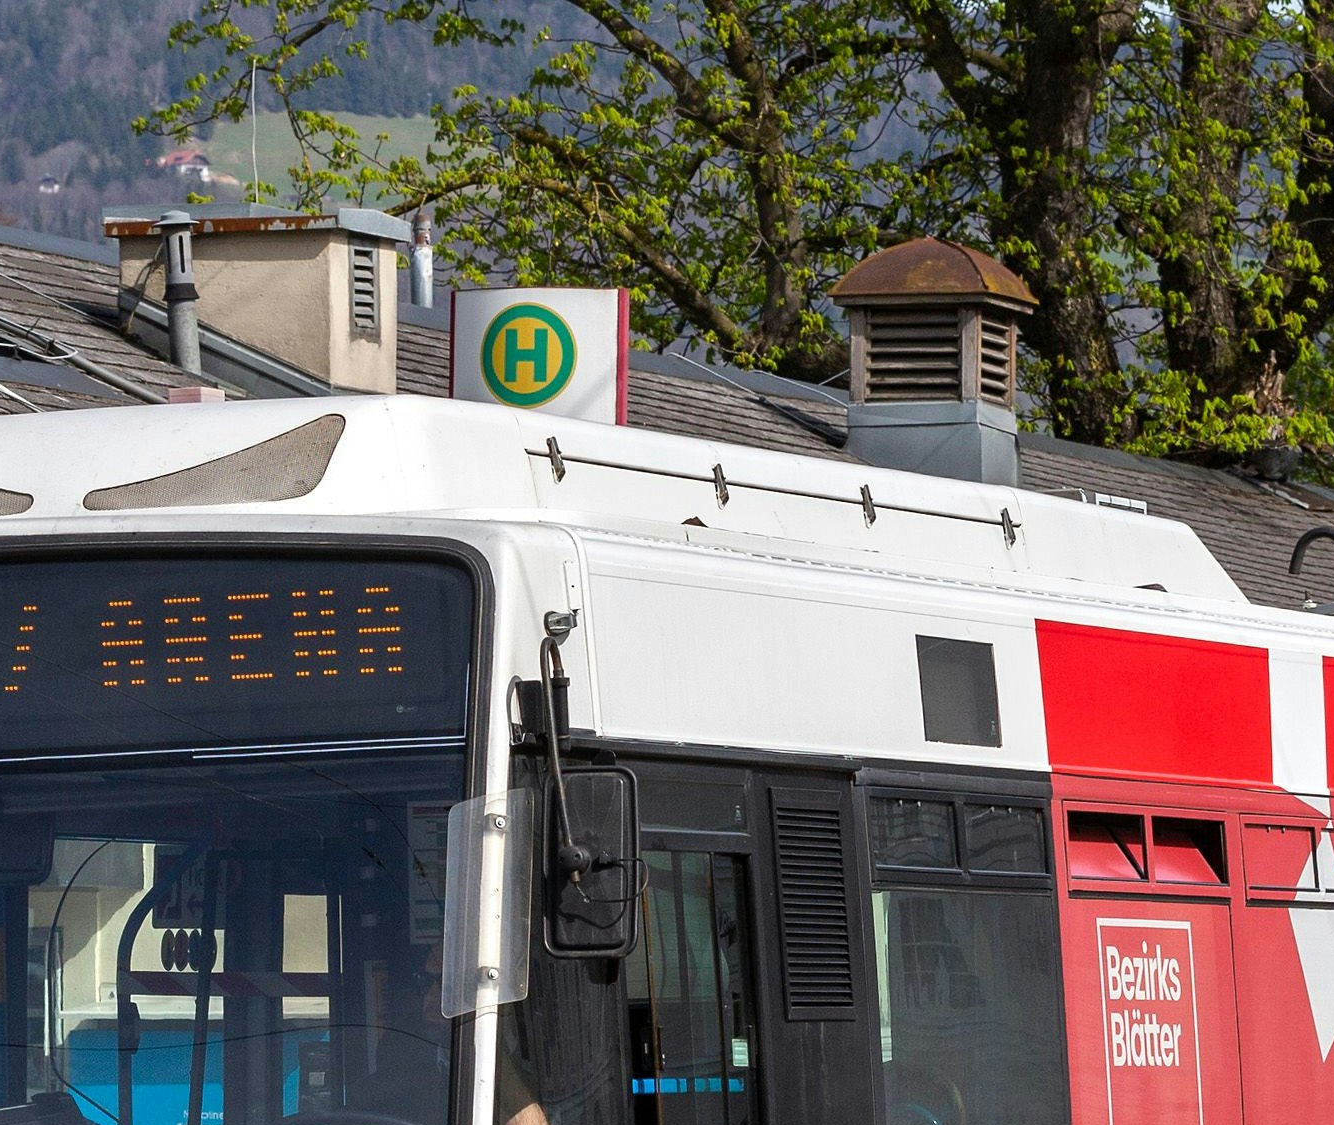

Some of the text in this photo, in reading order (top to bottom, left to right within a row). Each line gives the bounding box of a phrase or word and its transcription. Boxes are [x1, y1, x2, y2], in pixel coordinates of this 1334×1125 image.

[503, 328, 549, 383] H
[100, 586, 404, 687] ARENA
[1106, 940, 1182, 1002] Bezirks
[1110, 1009, 1182, 1067] Blätter
